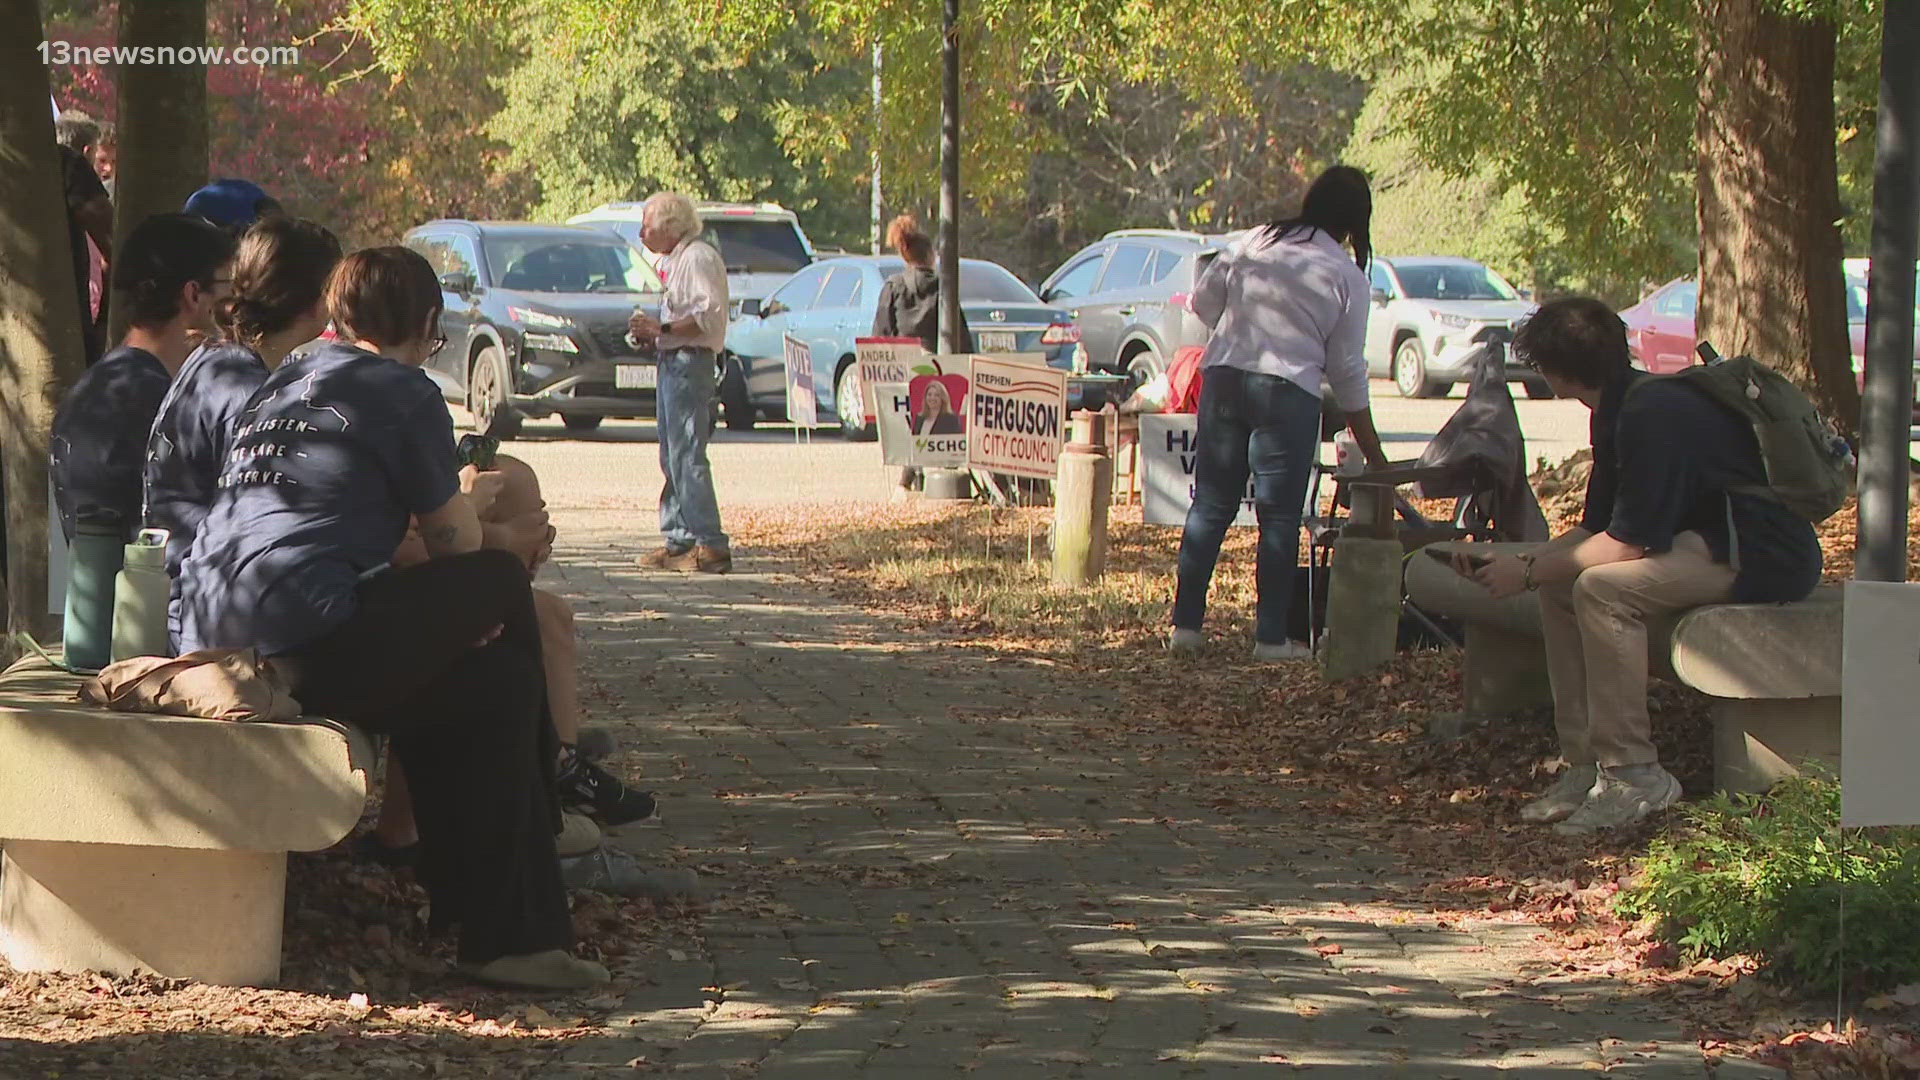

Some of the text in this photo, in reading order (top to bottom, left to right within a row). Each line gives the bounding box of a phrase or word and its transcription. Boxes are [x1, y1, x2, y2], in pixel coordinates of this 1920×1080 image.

[861, 350, 896, 362] ANDREA
[862, 364, 905, 381] DIGGS
[976, 373, 1011, 386] STEPHEN
[975, 394, 1058, 438] FERGUSON
[927, 440, 967, 452] SCHO
[983, 433, 1056, 463] CITY COUNCIL
